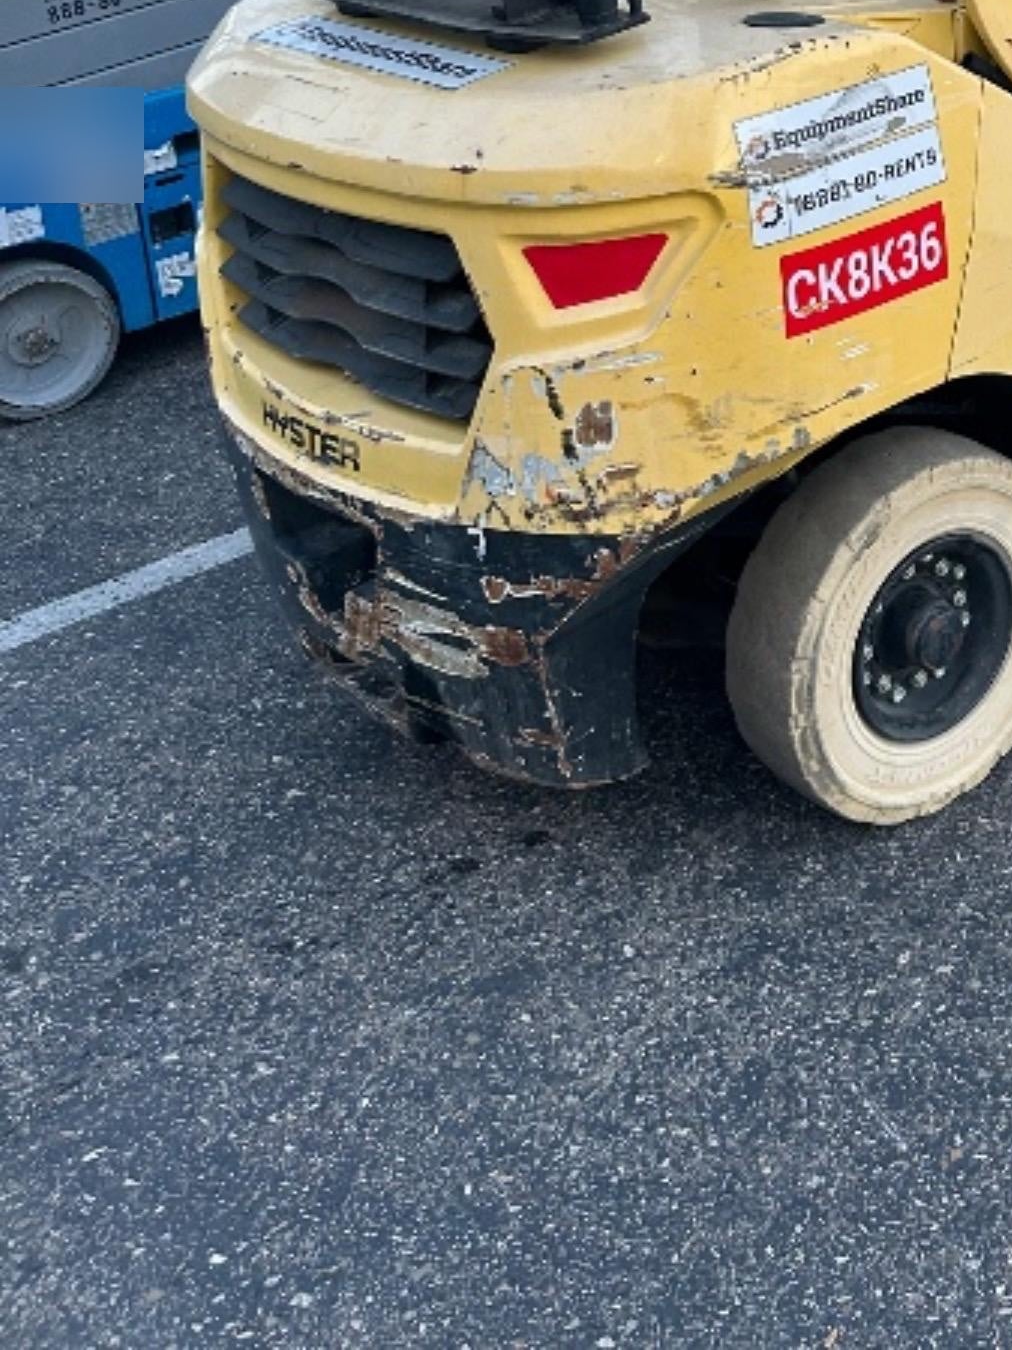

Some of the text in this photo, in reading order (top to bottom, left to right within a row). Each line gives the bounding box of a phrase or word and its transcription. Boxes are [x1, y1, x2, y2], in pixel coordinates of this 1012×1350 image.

[771, 88, 926, 152] EquipmentShare
[852, 148, 938, 194] 80-RENTS
[786, 220, 944, 320] CK8K36
[262, 400, 361, 472] HYSTER
